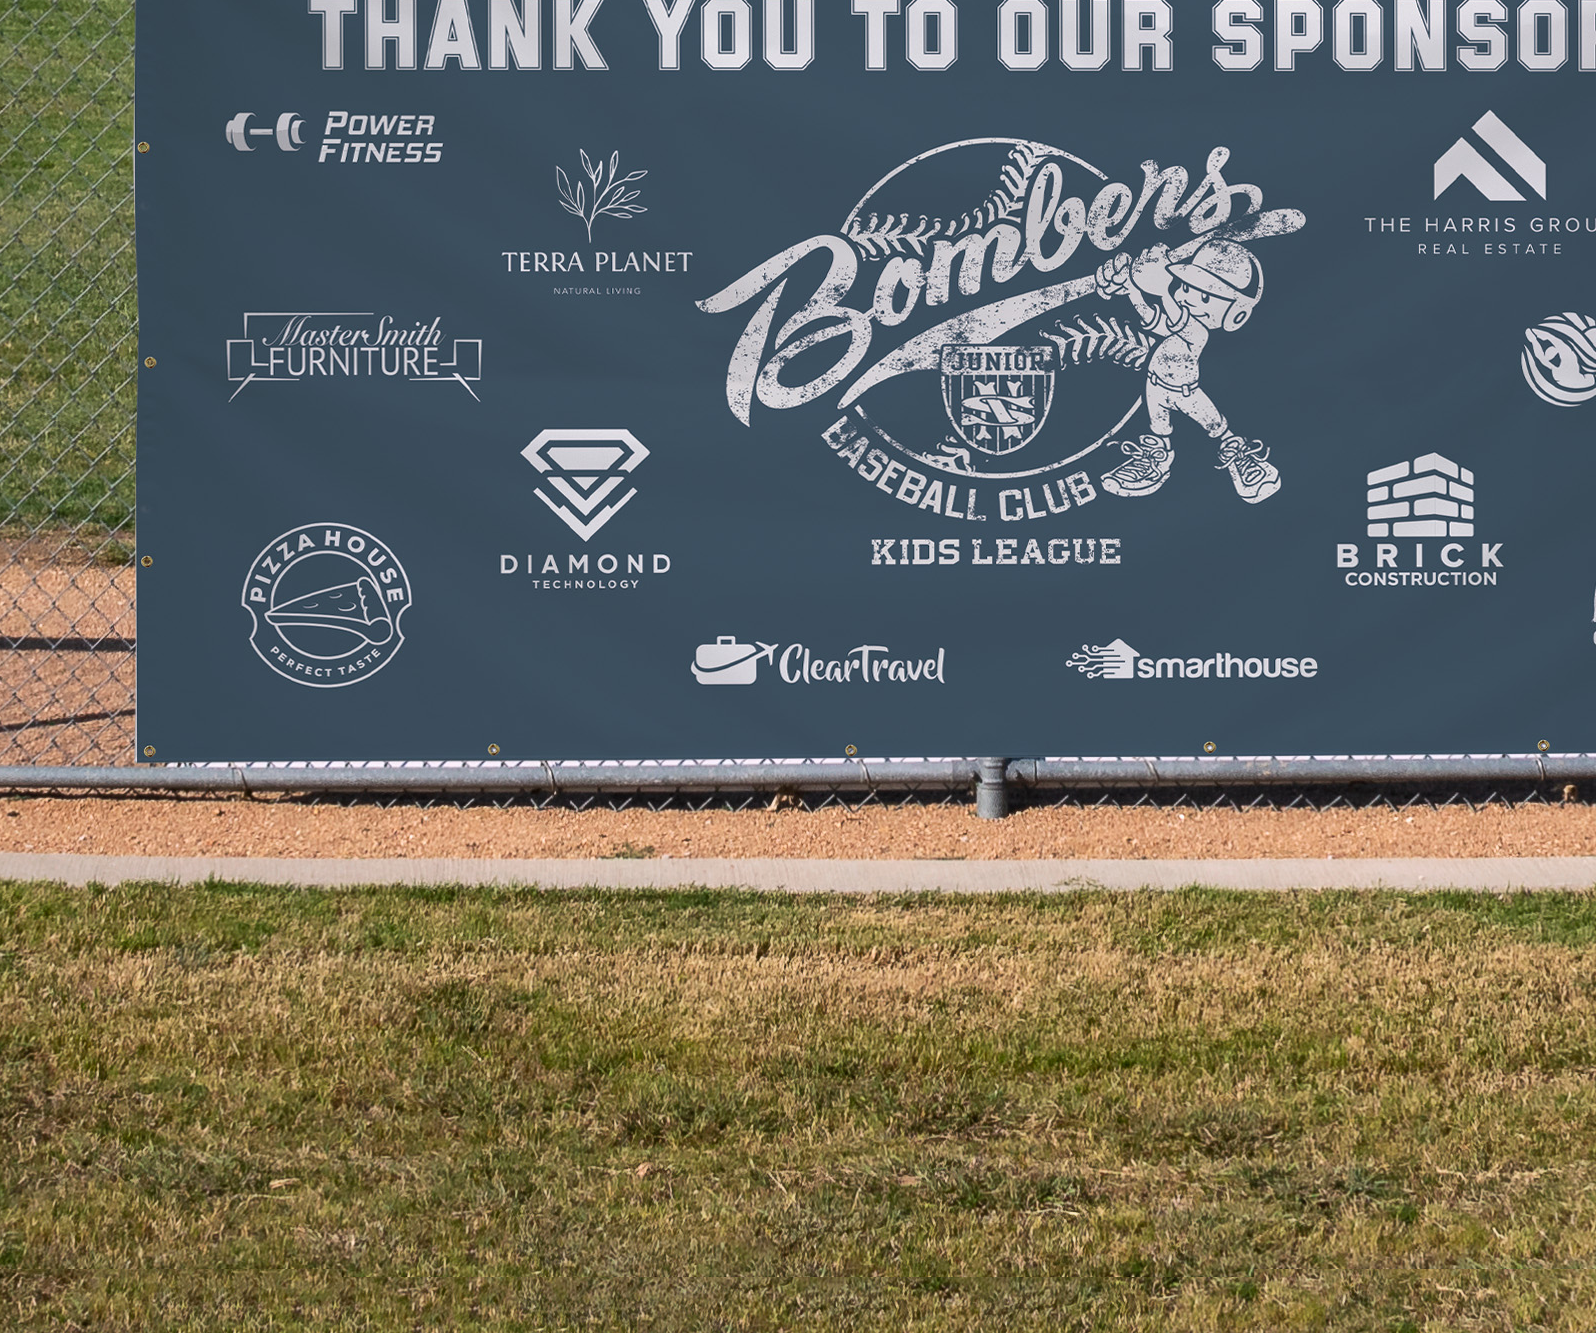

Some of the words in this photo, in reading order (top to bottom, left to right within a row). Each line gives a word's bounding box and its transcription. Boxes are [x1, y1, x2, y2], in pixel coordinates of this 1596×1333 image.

[1364, 218, 1410, 232] THE
[1426, 218, 1515, 232] HARRIS
[1419, 244, 1469, 254] REAL
[1485, 244, 1561, 254] ESTATE
[502, 252, 584, 272] TERRA
[595, 252, 693, 272] PLANET
[694, 144, 1264, 429] Bombers
[269, 347, 439, 376] FURNITURE
[951, 352, 1044, 371] JUNIOR
[821, 415, 987, 521] BASEBALL
[999, 470, 1097, 521] CLUB
[501, 554, 670, 574] DIAMOND
[871, 539, 960, 565] KIDS
[972, 538, 1121, 564] LEAGUE
[1337, 543, 1504, 568] BRICK
[249, 533, 316, 603] PIZZA
[324, 530, 404, 603] HOUSE
[1345, 572, 1496, 586] CONSTRUCTION
[532, 580, 638, 589] TECHNOLOGY
[270, 645, 332, 678] PERFECT
[337, 648, 382, 676] TASTE
[1137, 652, 1318, 679] smarthouse
